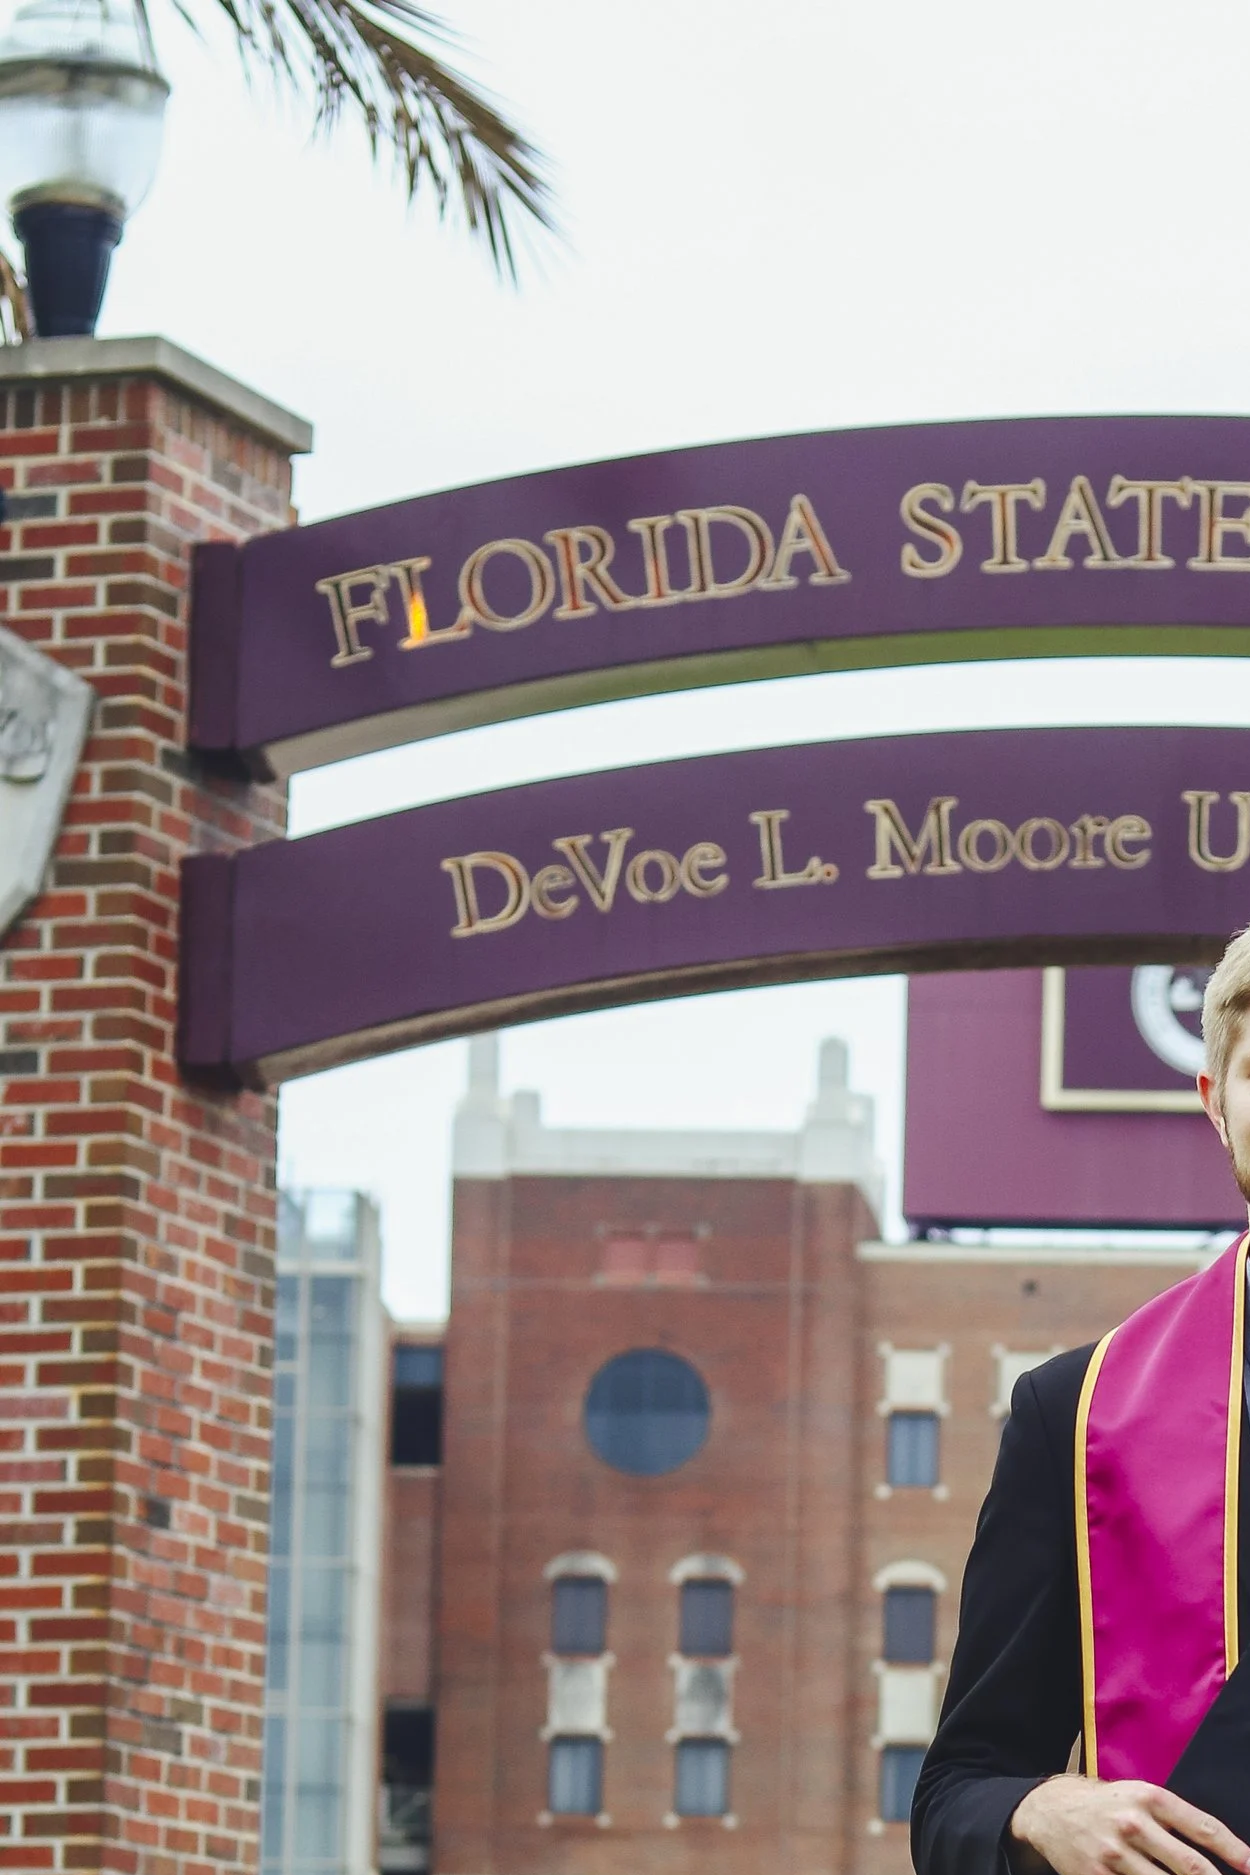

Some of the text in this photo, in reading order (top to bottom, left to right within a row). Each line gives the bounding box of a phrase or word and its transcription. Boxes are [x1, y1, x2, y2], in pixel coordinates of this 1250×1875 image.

[318, 493, 852, 668] FLORIDA
[441, 827, 728, 939] DeVoe
[750, 809, 838, 889] L.
[865, 797, 1152, 878] Moore
